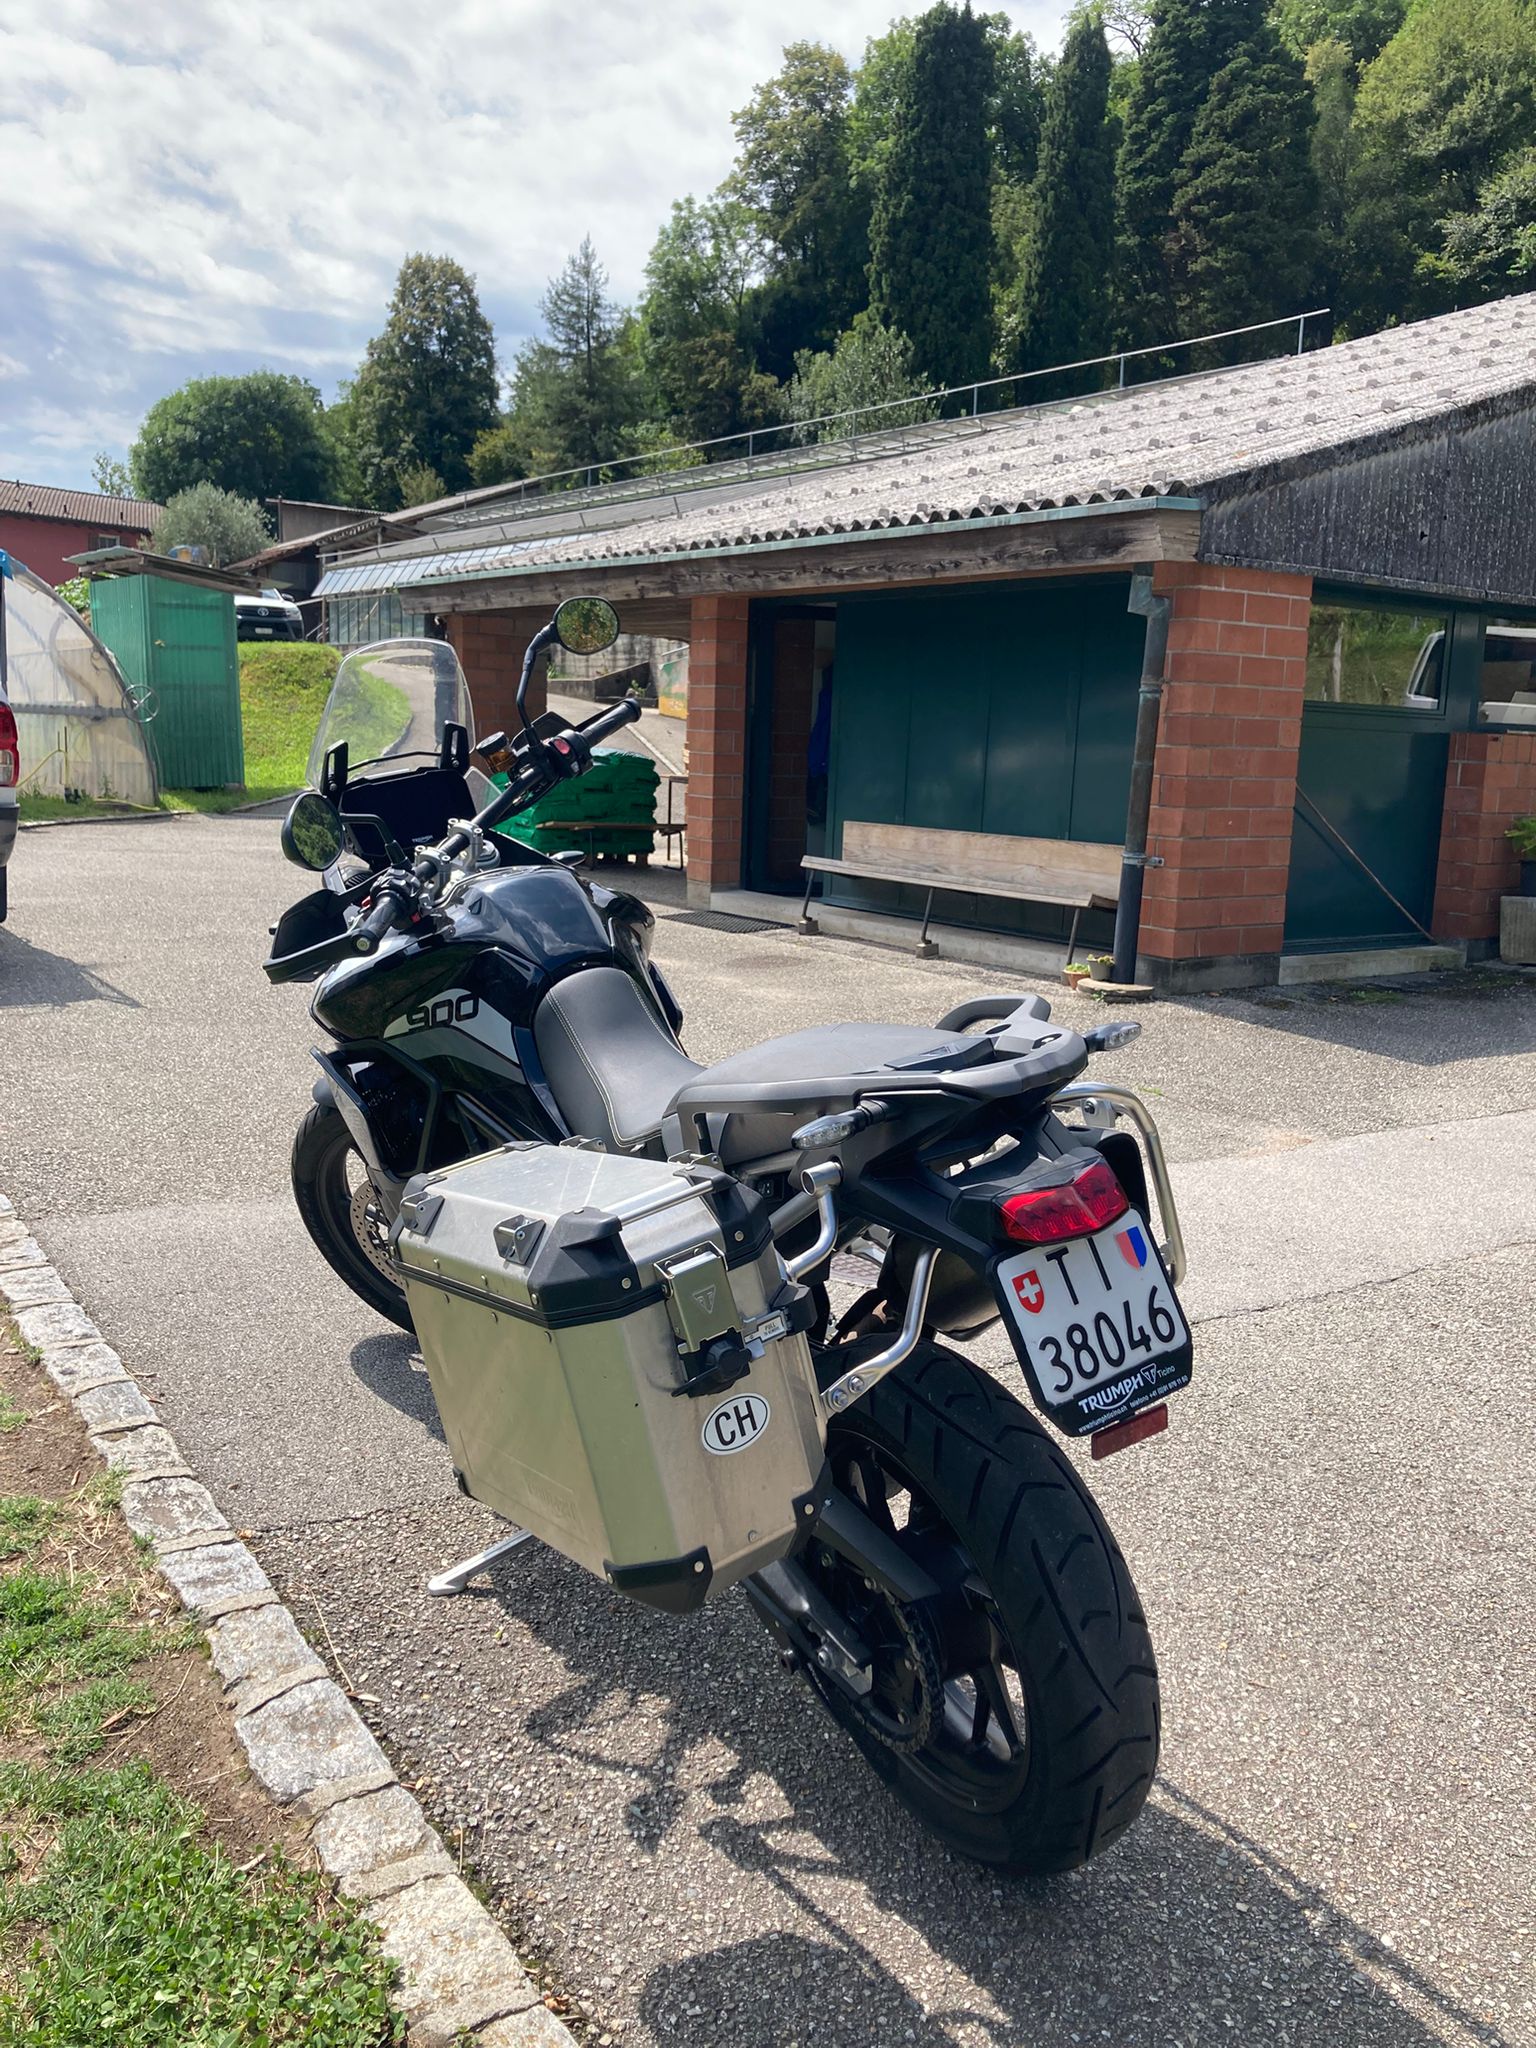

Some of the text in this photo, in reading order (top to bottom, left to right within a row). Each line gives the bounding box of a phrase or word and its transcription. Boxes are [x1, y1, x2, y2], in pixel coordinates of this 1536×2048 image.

[406, 993, 479, 1029] 900
[1046, 1237, 1112, 1305] TI
[1039, 1285, 1175, 1393] 38046
[1078, 1365, 1175, 1413] TRIUMPH Ticino
[715, 1400, 758, 1446] CH
